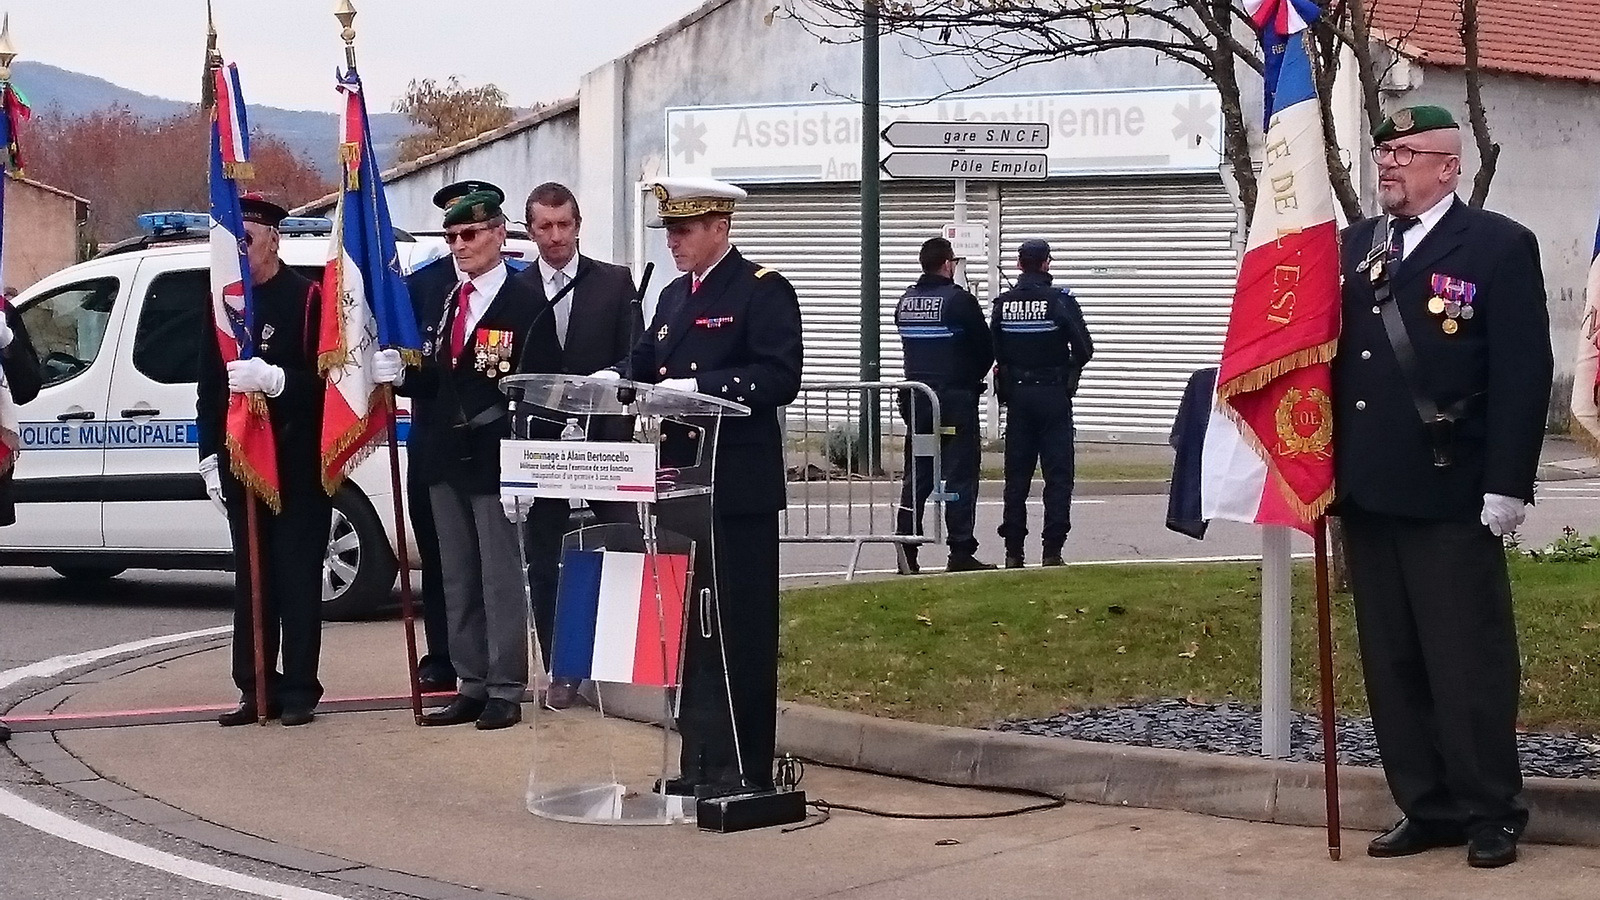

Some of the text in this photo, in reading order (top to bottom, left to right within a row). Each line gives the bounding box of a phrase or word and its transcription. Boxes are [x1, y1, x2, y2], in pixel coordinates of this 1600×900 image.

[944, 129, 1044, 145] gare S.N.C.F.
[950, 158, 1043, 175] Pôle Emploi
[1270, 170, 1299, 215] DE
[901, 298, 940, 311] POLICE
[1002, 300, 1048, 313] POLICE
[79, 425, 185, 445] MUNICIPALE
[523, 449, 630, 463] Hommage à Alain Bertoncello
[593, 464, 599, 472] de
[610, 464, 634, 473] fonctions
